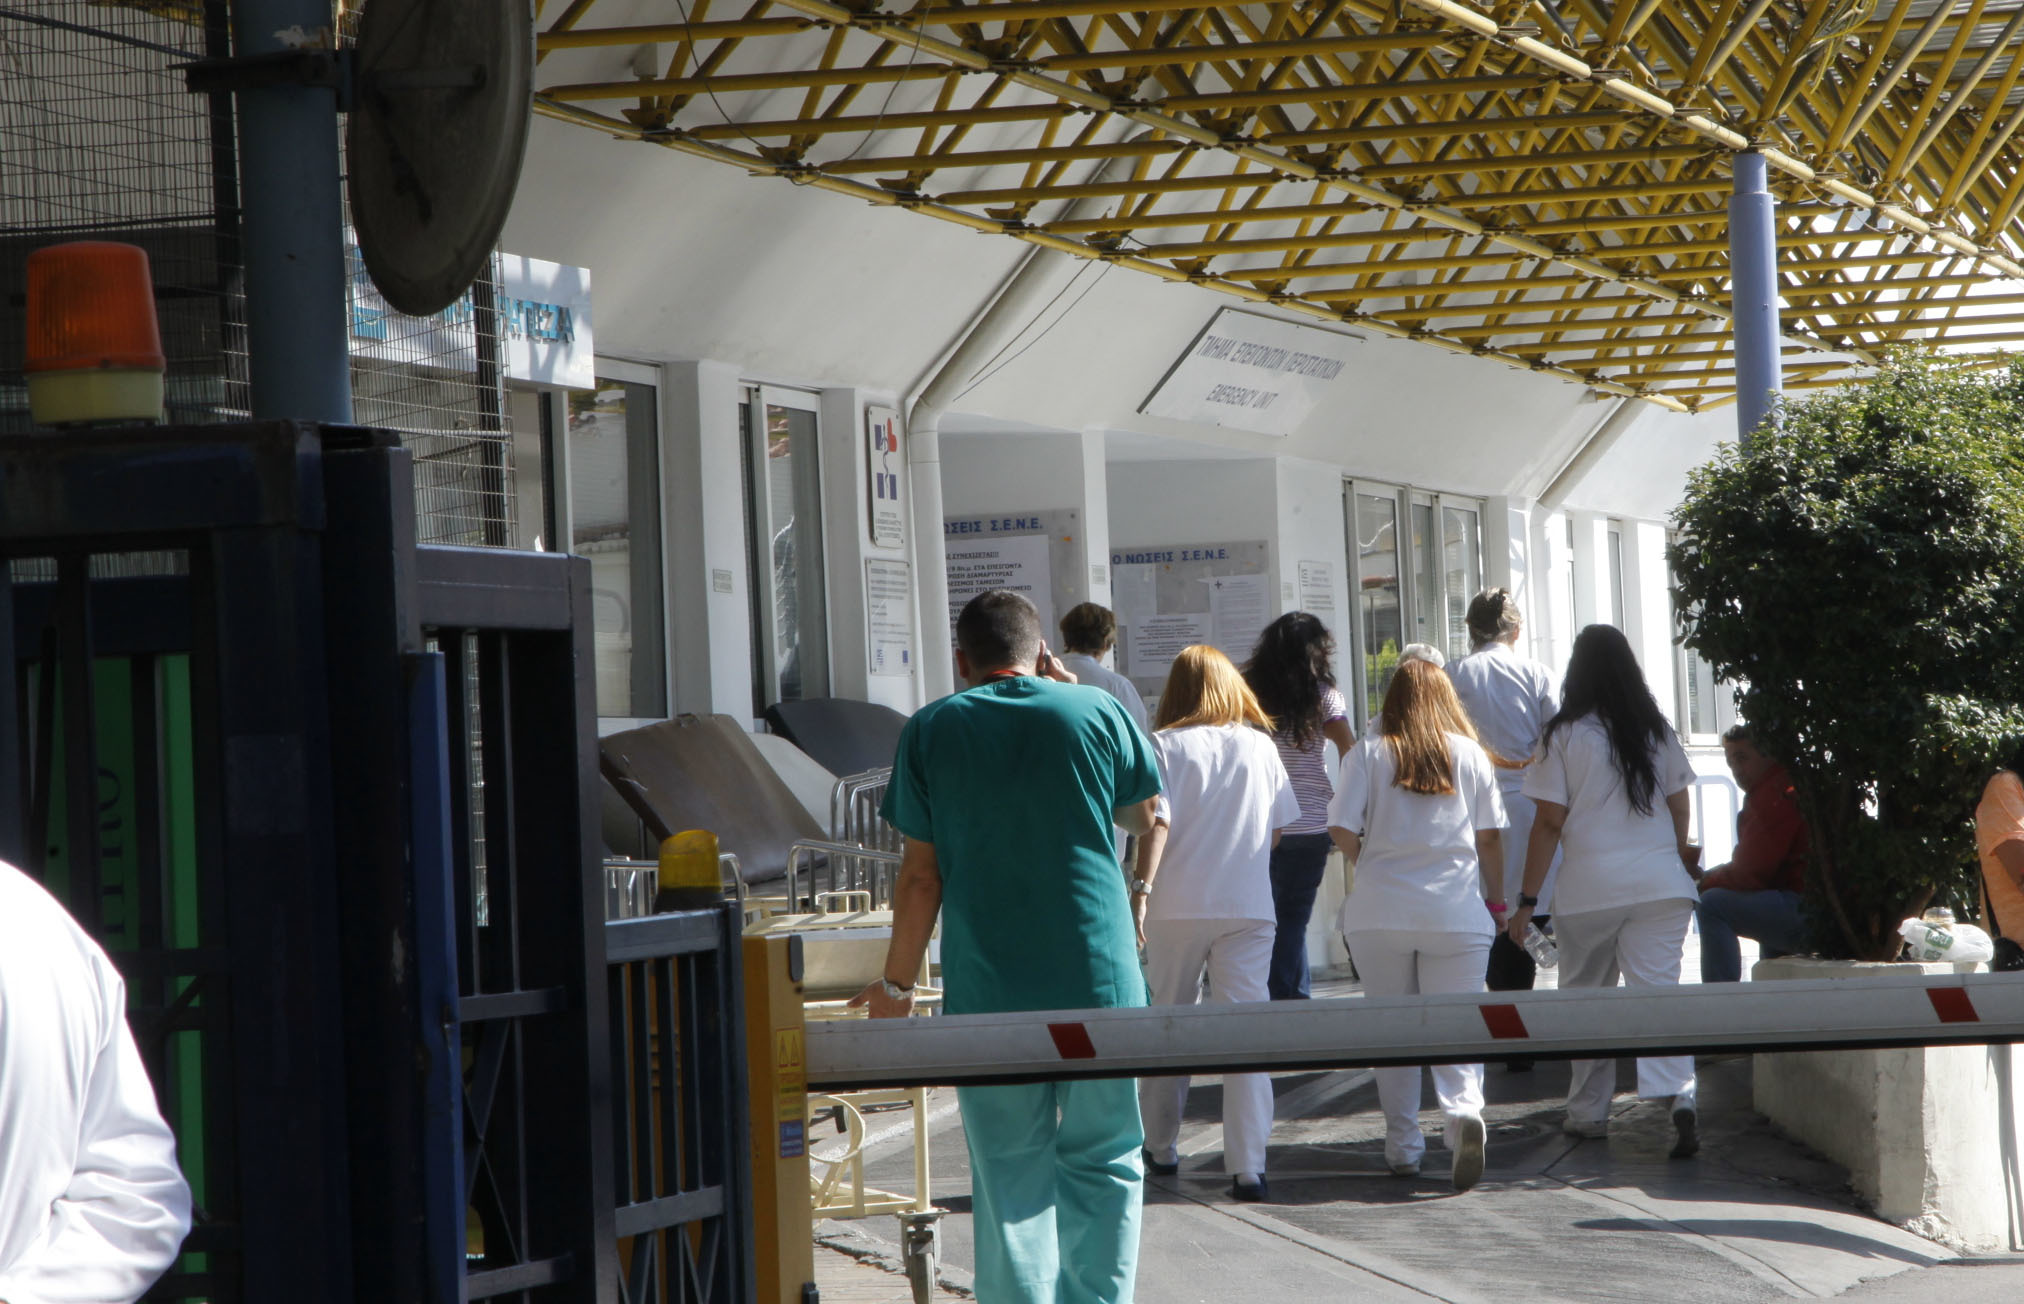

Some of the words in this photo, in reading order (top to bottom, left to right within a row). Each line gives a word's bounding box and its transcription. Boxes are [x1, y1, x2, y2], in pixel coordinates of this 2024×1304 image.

[1196, 334, 1237, 361] ΤΜΗΜΑ
[1205, 383, 1259, 407] EMERGENCY
[1252, 391, 1279, 409] UNIT
[990, 517, 1043, 532] Σ.Ε.Ν.Ε.
[1182, 548, 1229, 561] Σ.Ε.Ν.Ε.
